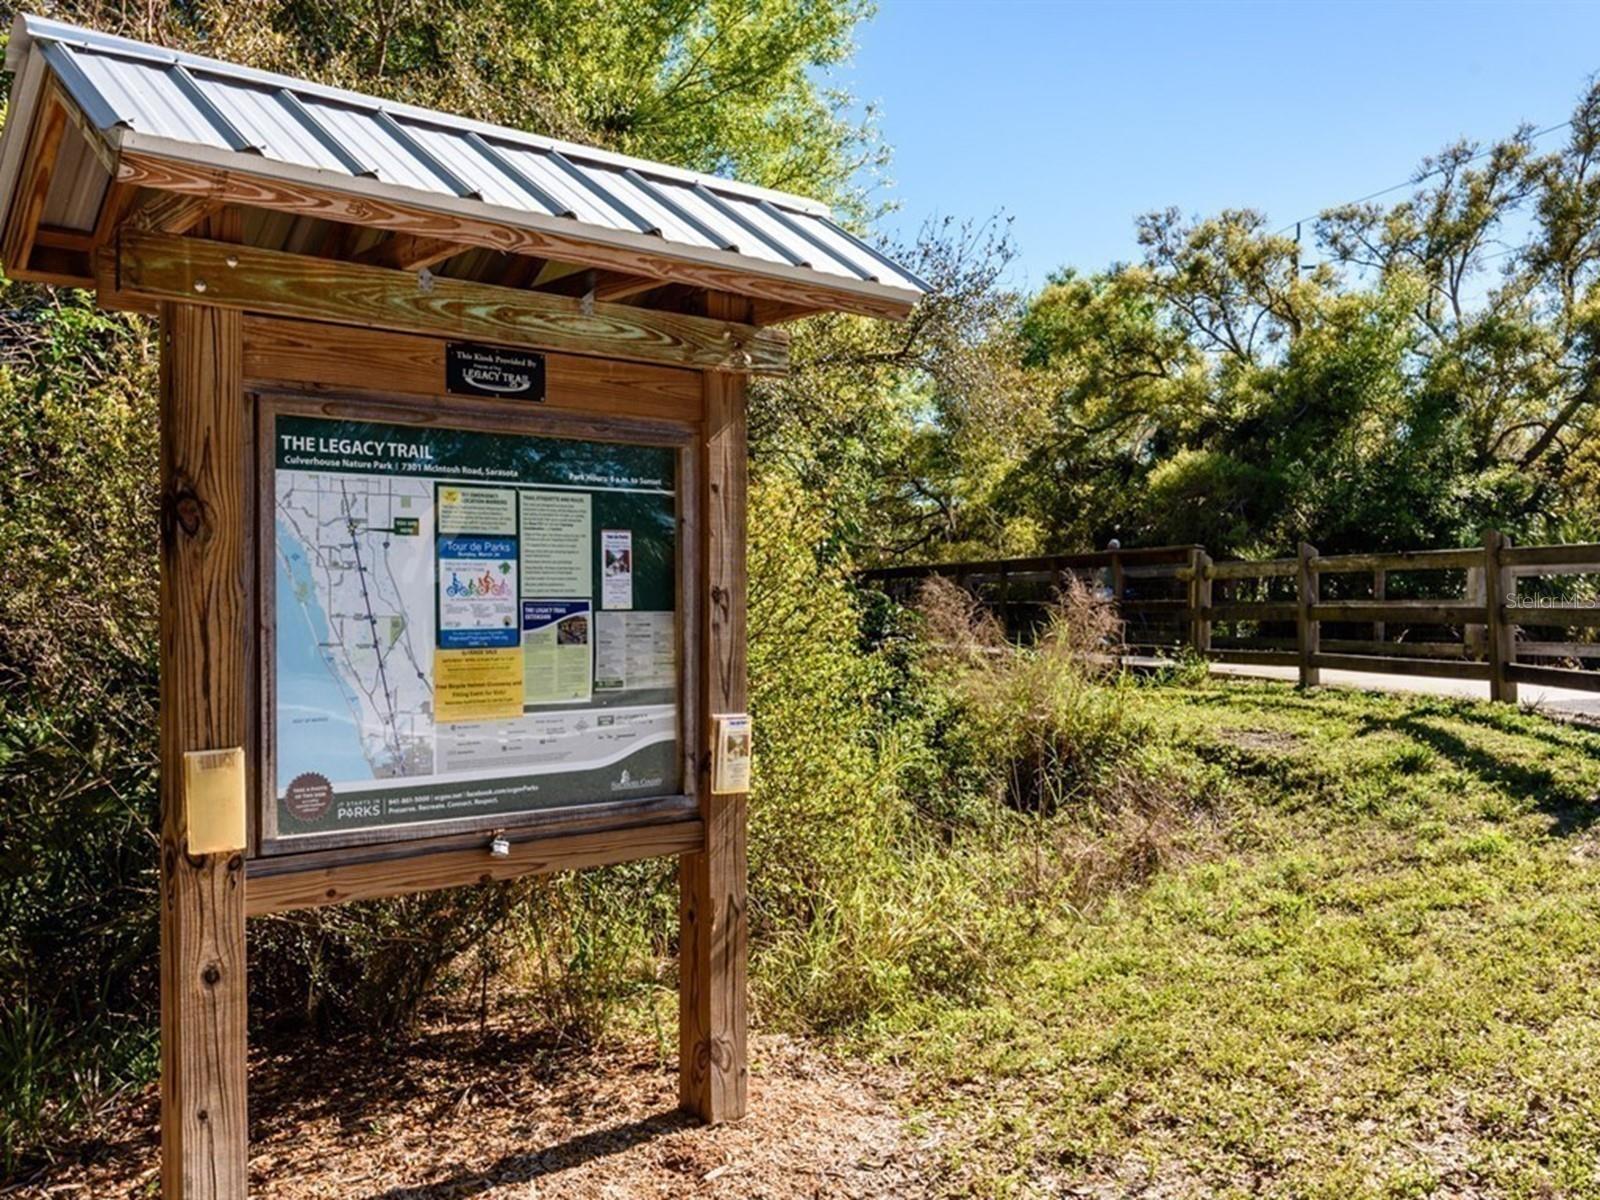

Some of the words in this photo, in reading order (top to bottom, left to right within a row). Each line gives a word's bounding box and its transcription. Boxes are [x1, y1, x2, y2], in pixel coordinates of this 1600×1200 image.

[456, 351, 472, 359] This
[474, 353, 494, 363] Kiosk
[495, 356, 526, 366] Provided
[527, 359, 537, 368] By
[462, 368, 501, 381] LEGACY
[502, 372, 529, 383] TRAIL
[281, 434, 316, 452] THE
[319, 437, 385, 456] LEGACY
[387, 442, 433, 460] TRAIL
[284, 455, 341, 468] Culverhouse
[342, 459, 372, 469] Nature
[373, 461, 393, 470] Park
[401, 463, 422, 471] 7301
[424, 463, 460, 473] McIntosh
[462, 466, 485, 476] Road,
[485, 467, 519, 477] Sarasota
[447, 541, 468, 551] Tour
[469, 541, 482, 551] de
[484, 541, 511, 552] Parks
[337, 805, 381, 819] PARKS
